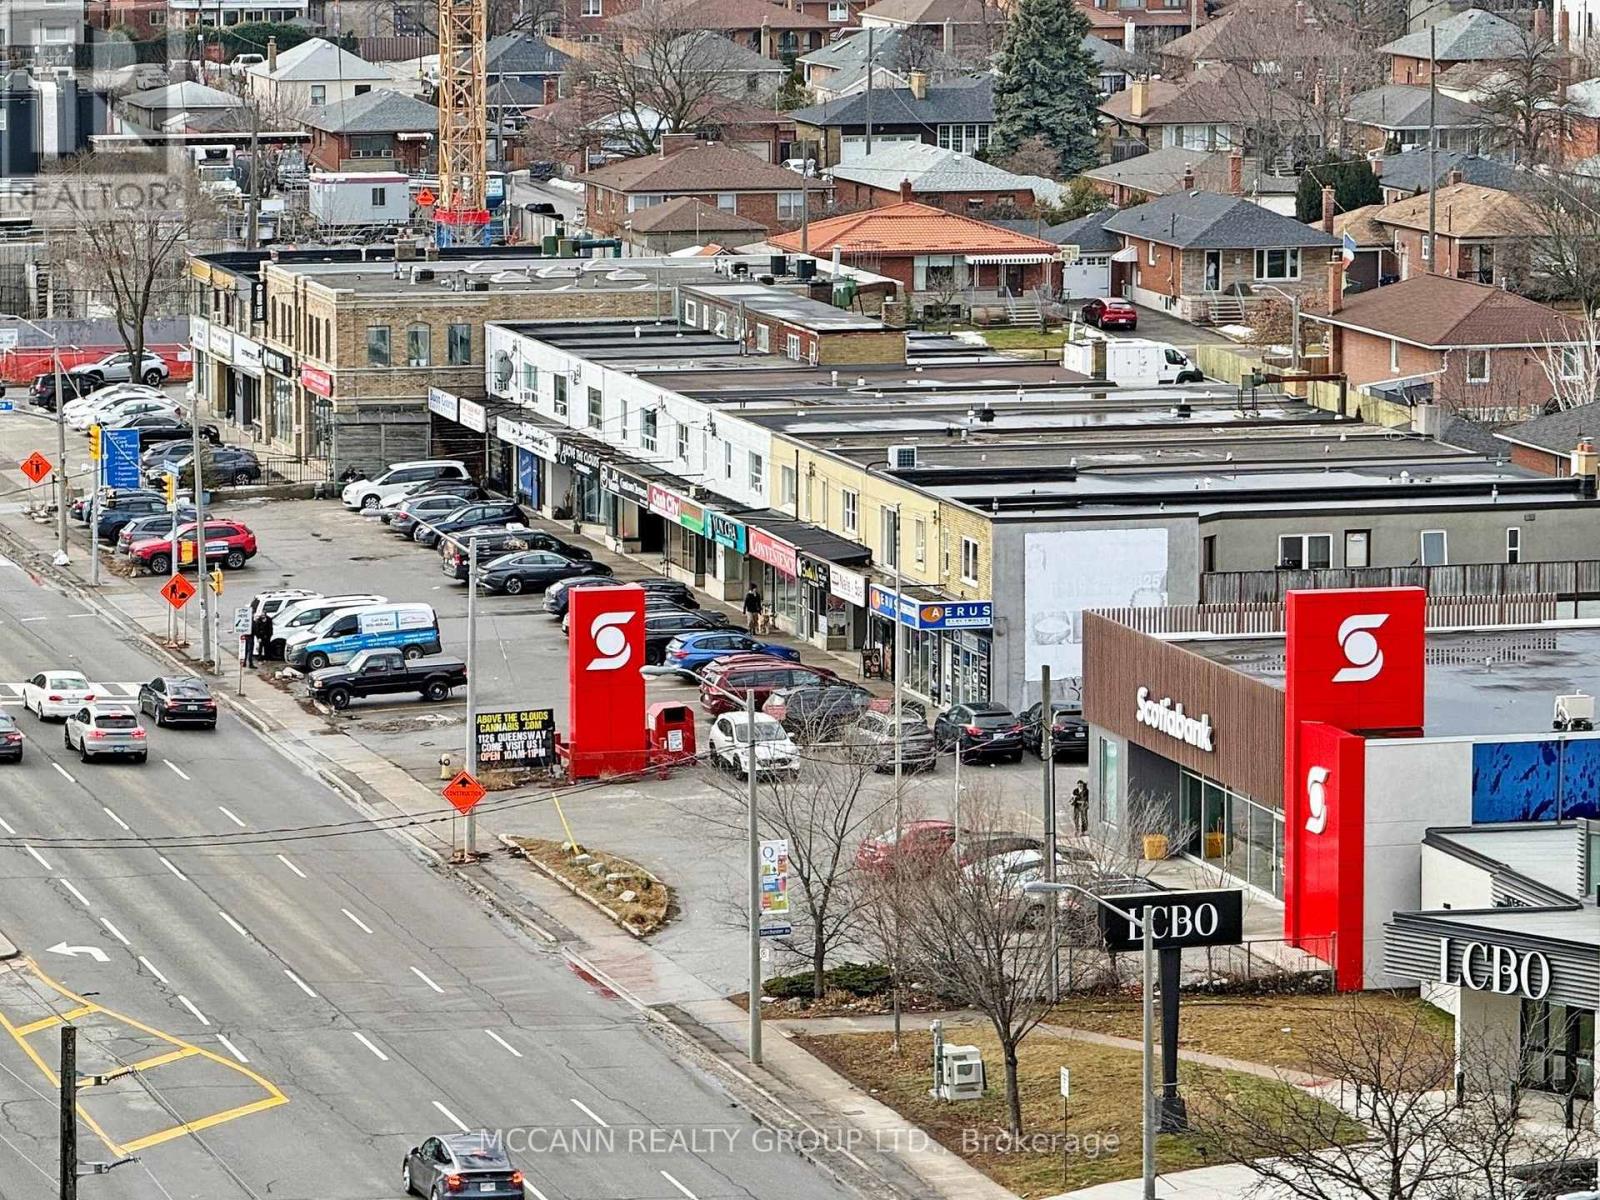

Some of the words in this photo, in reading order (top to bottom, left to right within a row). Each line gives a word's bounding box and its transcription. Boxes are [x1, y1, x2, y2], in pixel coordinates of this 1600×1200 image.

[931, 605, 991, 617] AERUS
[477, 714, 502, 724] ABOVE
[504, 713, 518, 722] THE
[520, 711, 549, 721] CLOUDS
[1136, 686, 1213, 752] Scotiabank
[480, 722, 519, 733] CANNABIS
[522, 721, 542, 730] .COM
[478, 733, 495, 743] 1126
[497, 730, 547, 742] QUEENSWAY
[481, 741, 504, 752] COME
[505, 740, 525, 750] VISIT
[480, 751, 501, 761] OPEN
[1127, 903, 1219, 941] LCBO
[1439, 937, 1551, 1000] LCBO
